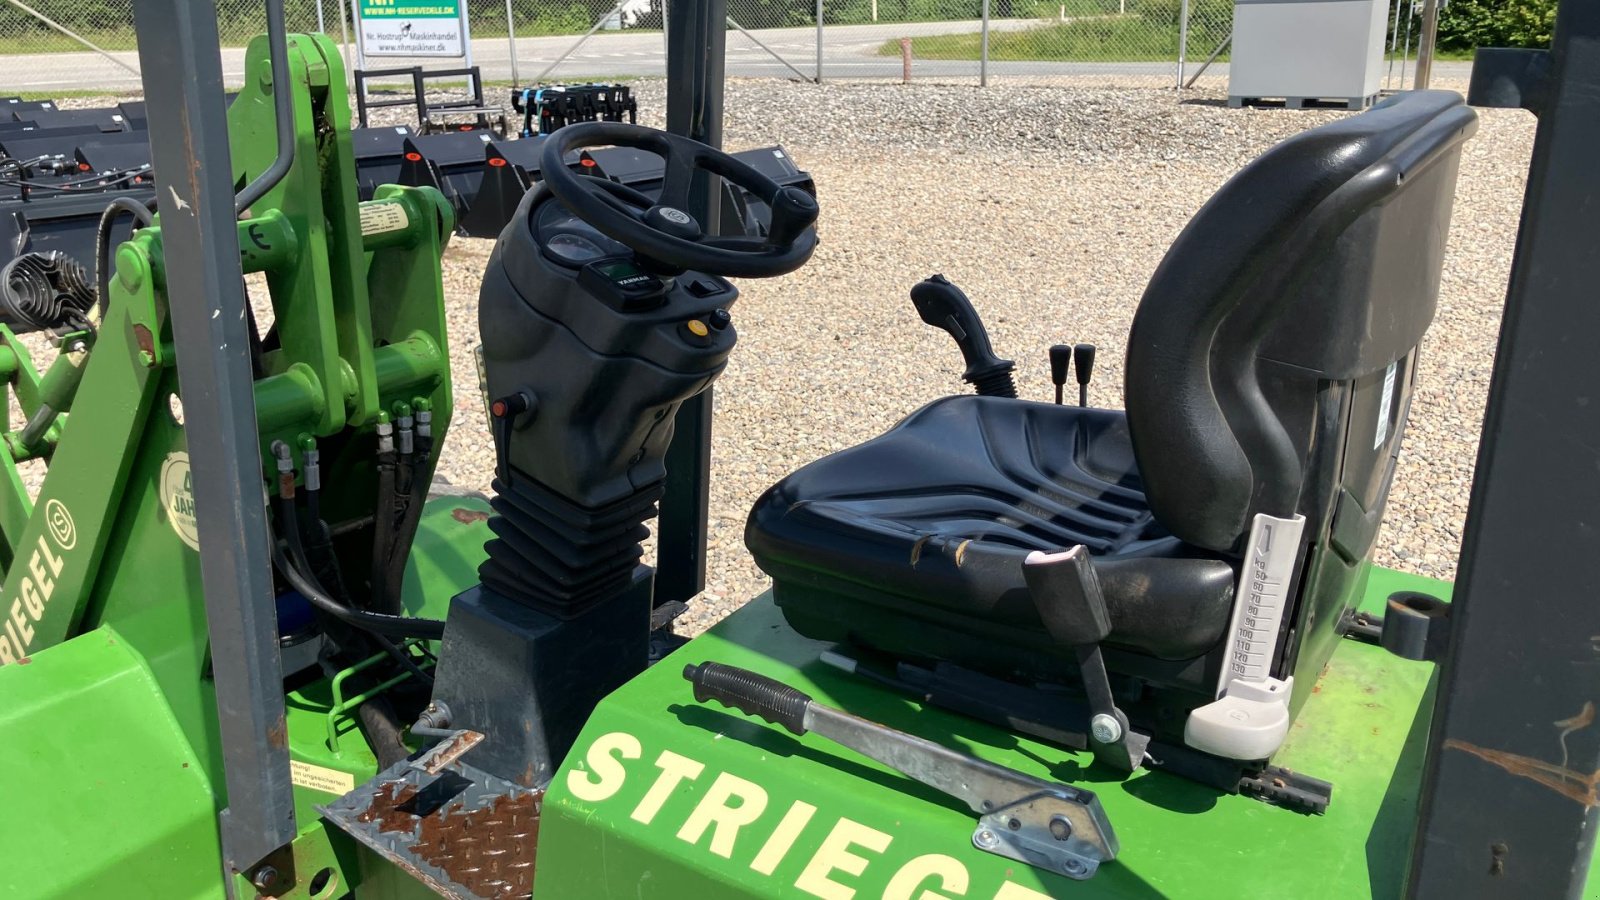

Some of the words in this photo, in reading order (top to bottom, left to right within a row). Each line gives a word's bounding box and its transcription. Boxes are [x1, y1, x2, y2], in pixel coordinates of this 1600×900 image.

[377, 32, 403, 42] Hostrup
[409, 32, 457, 41] Maskinhandel
[379, 43, 446, 51] www.nhmaskiner.dk
[617, 275, 650, 285] YANMAR
[1254, 557, 1266, 570] kg
[1255, 570, 1266, 581] 50
[1253, 582, 1264, 592] 60
[1250, 593, 1261, 604] 70
[1247, 605, 1258, 616] 80
[1245, 617, 1256, 628] 90
[1239, 628, 1253, 640] 100
[1236, 640, 1251, 652] 110
[1233, 651, 1248, 663] 120
[1231, 662, 1246, 674] 130
[567, 732, 1058, 900] STRIEG
